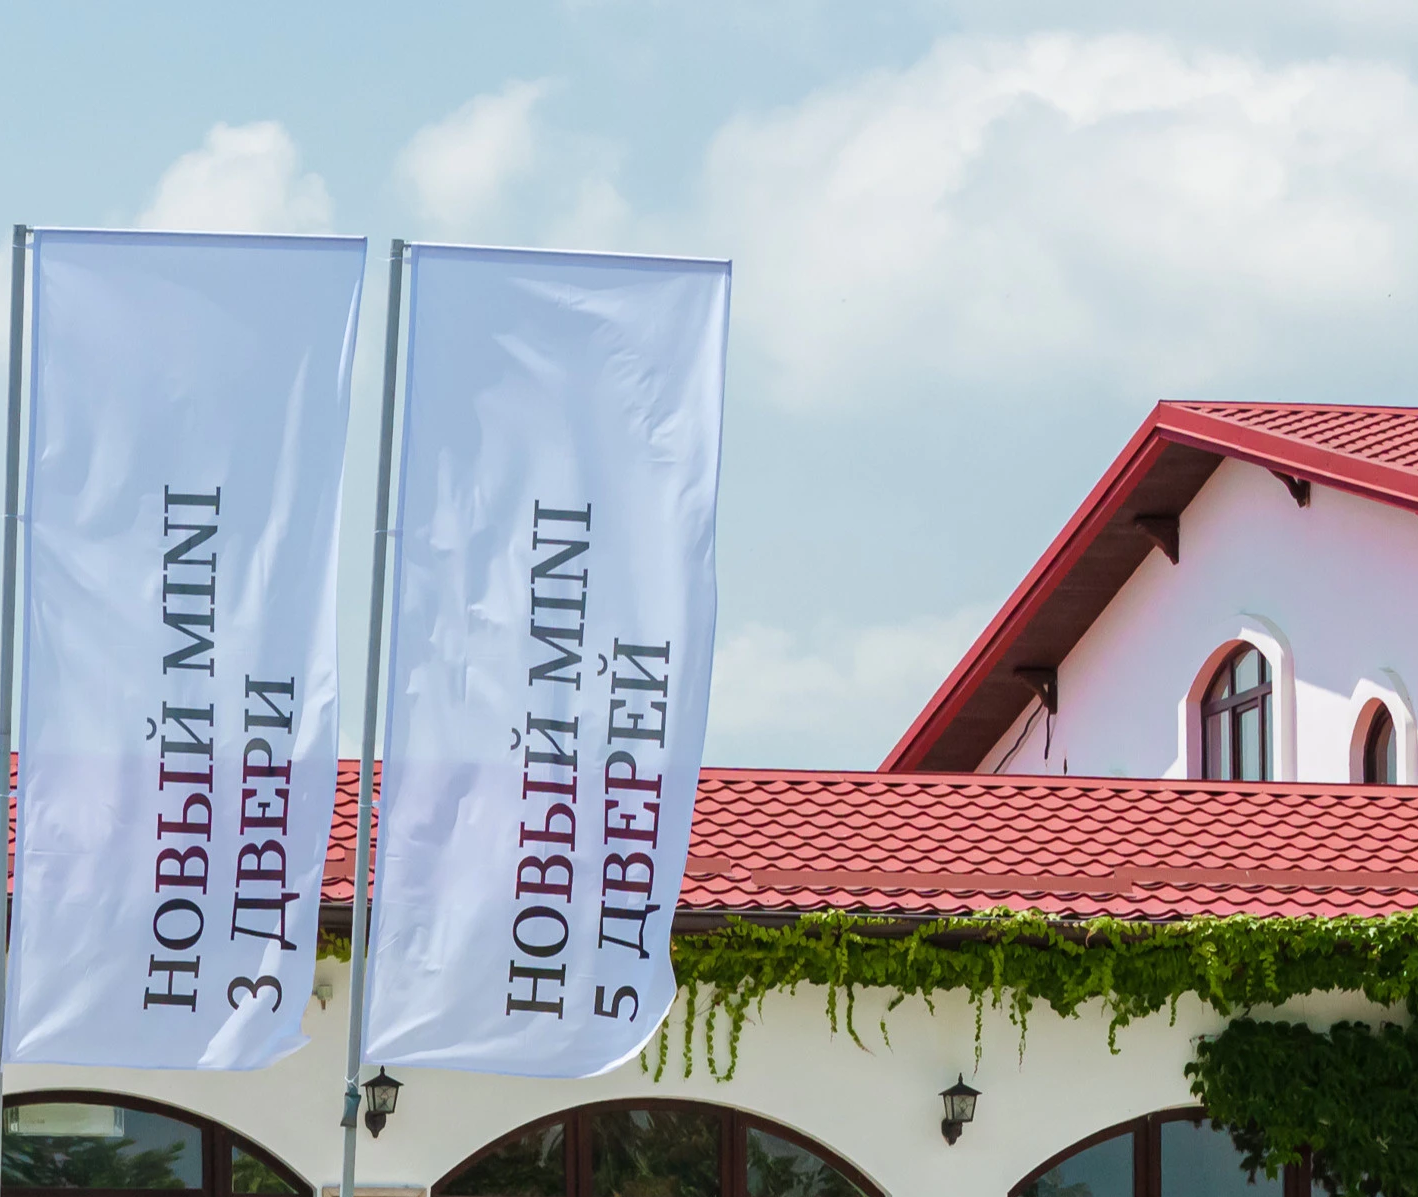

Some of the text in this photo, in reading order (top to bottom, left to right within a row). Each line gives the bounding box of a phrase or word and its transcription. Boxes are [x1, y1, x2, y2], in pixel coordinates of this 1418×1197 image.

[143, 485, 221, 1013] НОВЫЙ MINI
[227, 674, 301, 1014] 3 ДВЕРИ
[505, 499, 592, 1020] НОВЫЙ MINI
[594, 637, 671, 1023] 5 ДВЕРЕЙ
